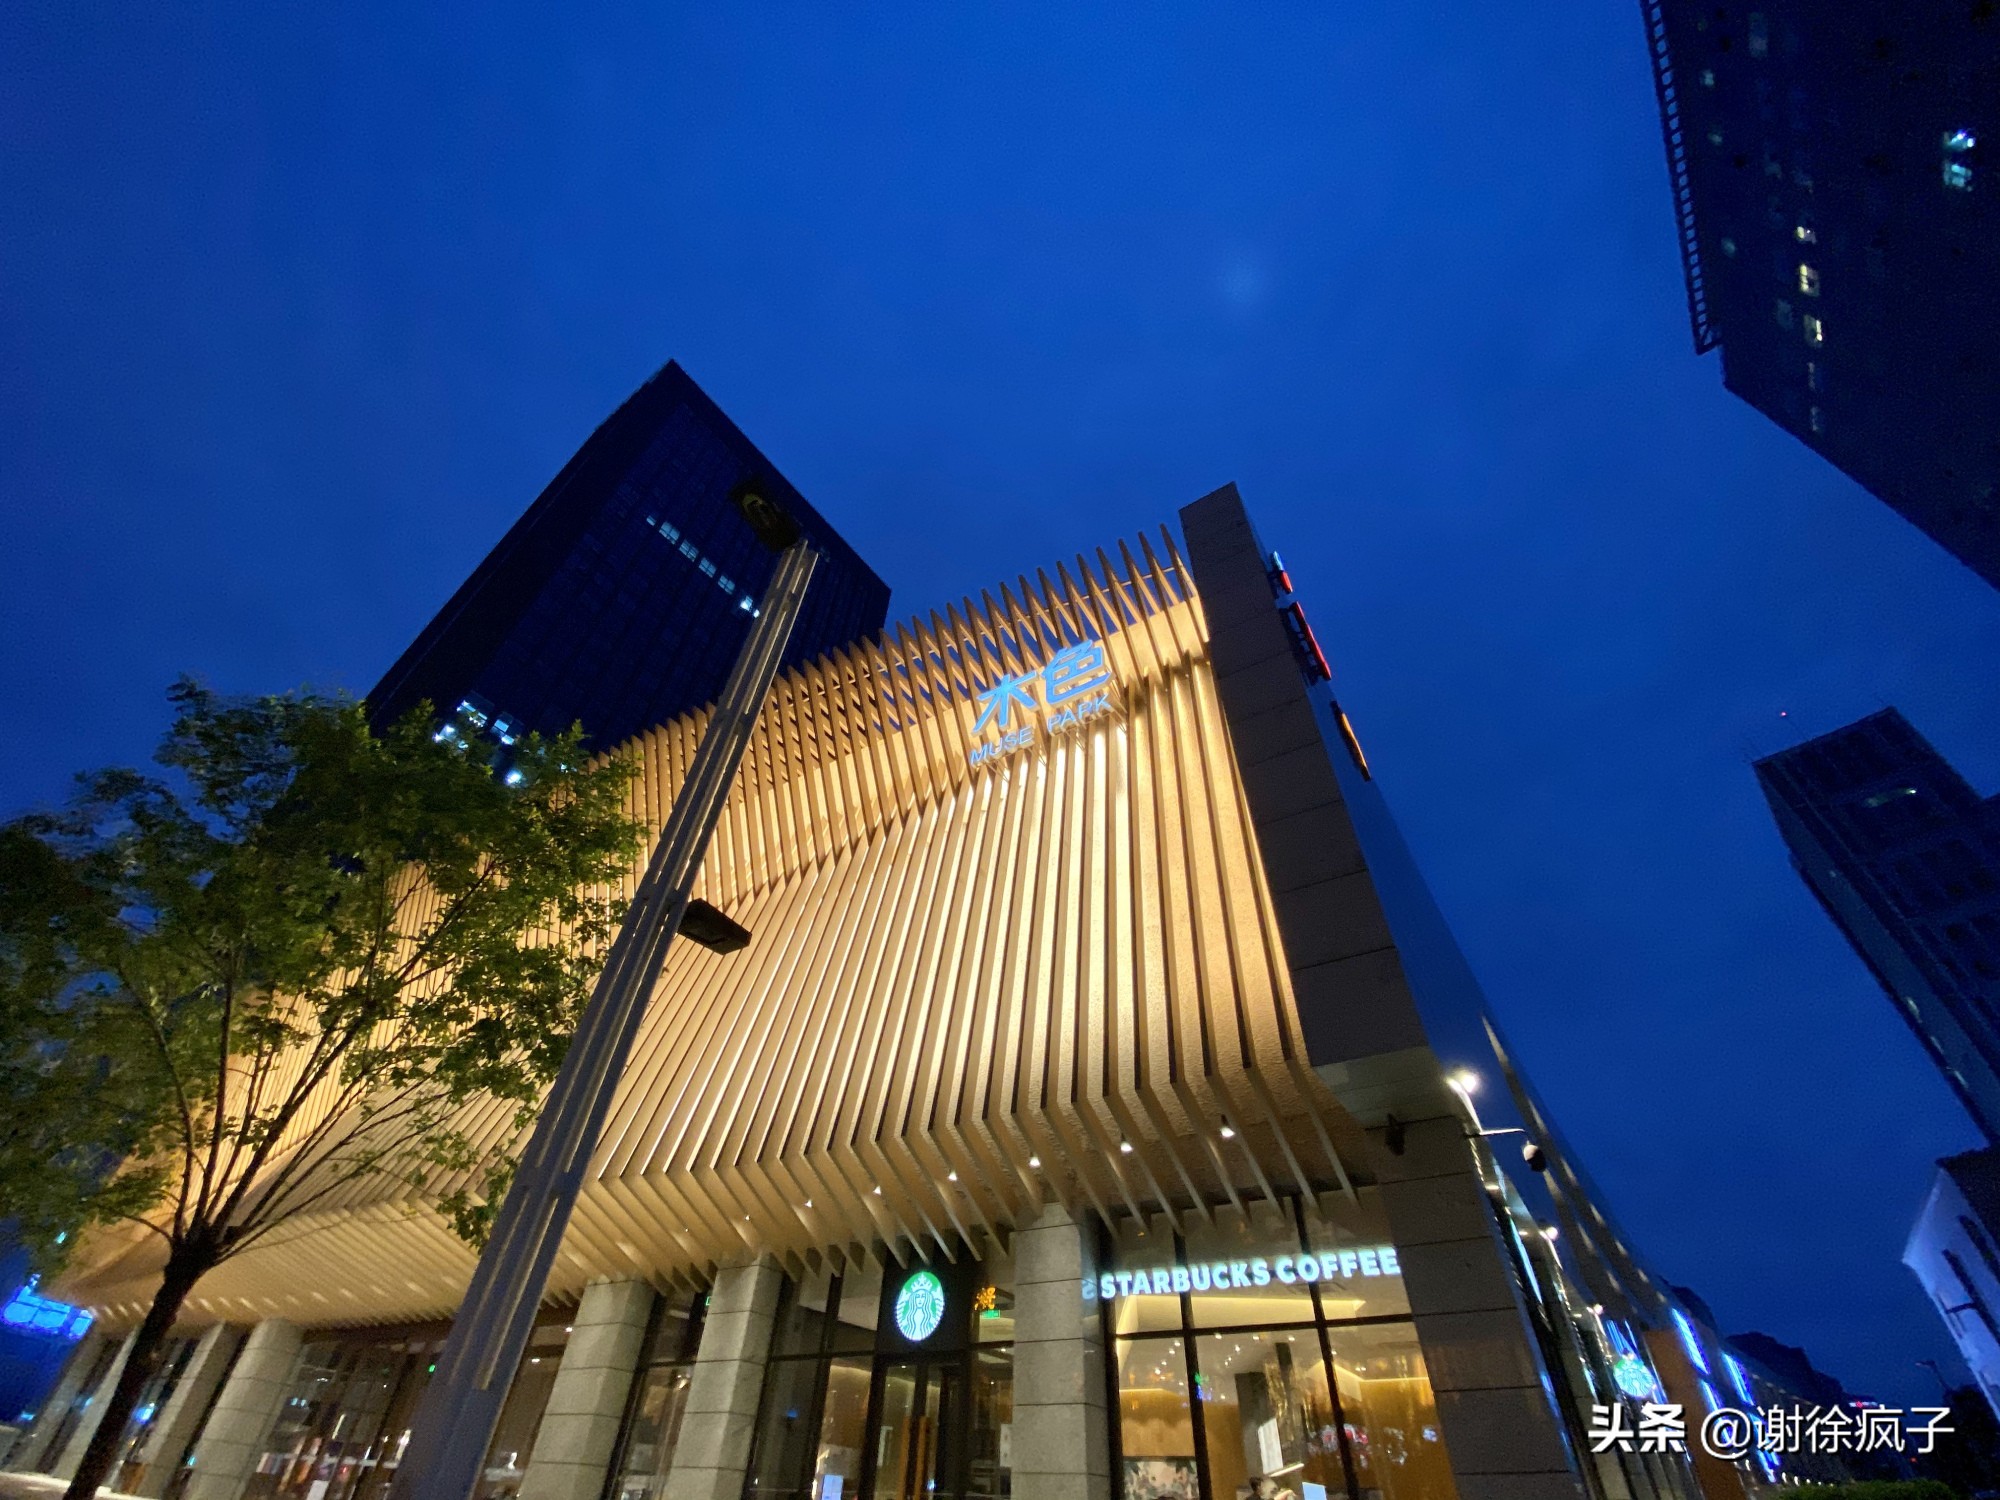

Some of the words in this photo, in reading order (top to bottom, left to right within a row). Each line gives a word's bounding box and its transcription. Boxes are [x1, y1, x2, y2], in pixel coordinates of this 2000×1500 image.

[972, 640, 1111, 733] 木色
[970, 728, 1033, 765] MUSE
[1047, 695, 1111, 732] PARK
[1101, 1260, 1270, 1299] STARBUCKS
[1275, 1248, 1401, 1282] COFFEE
